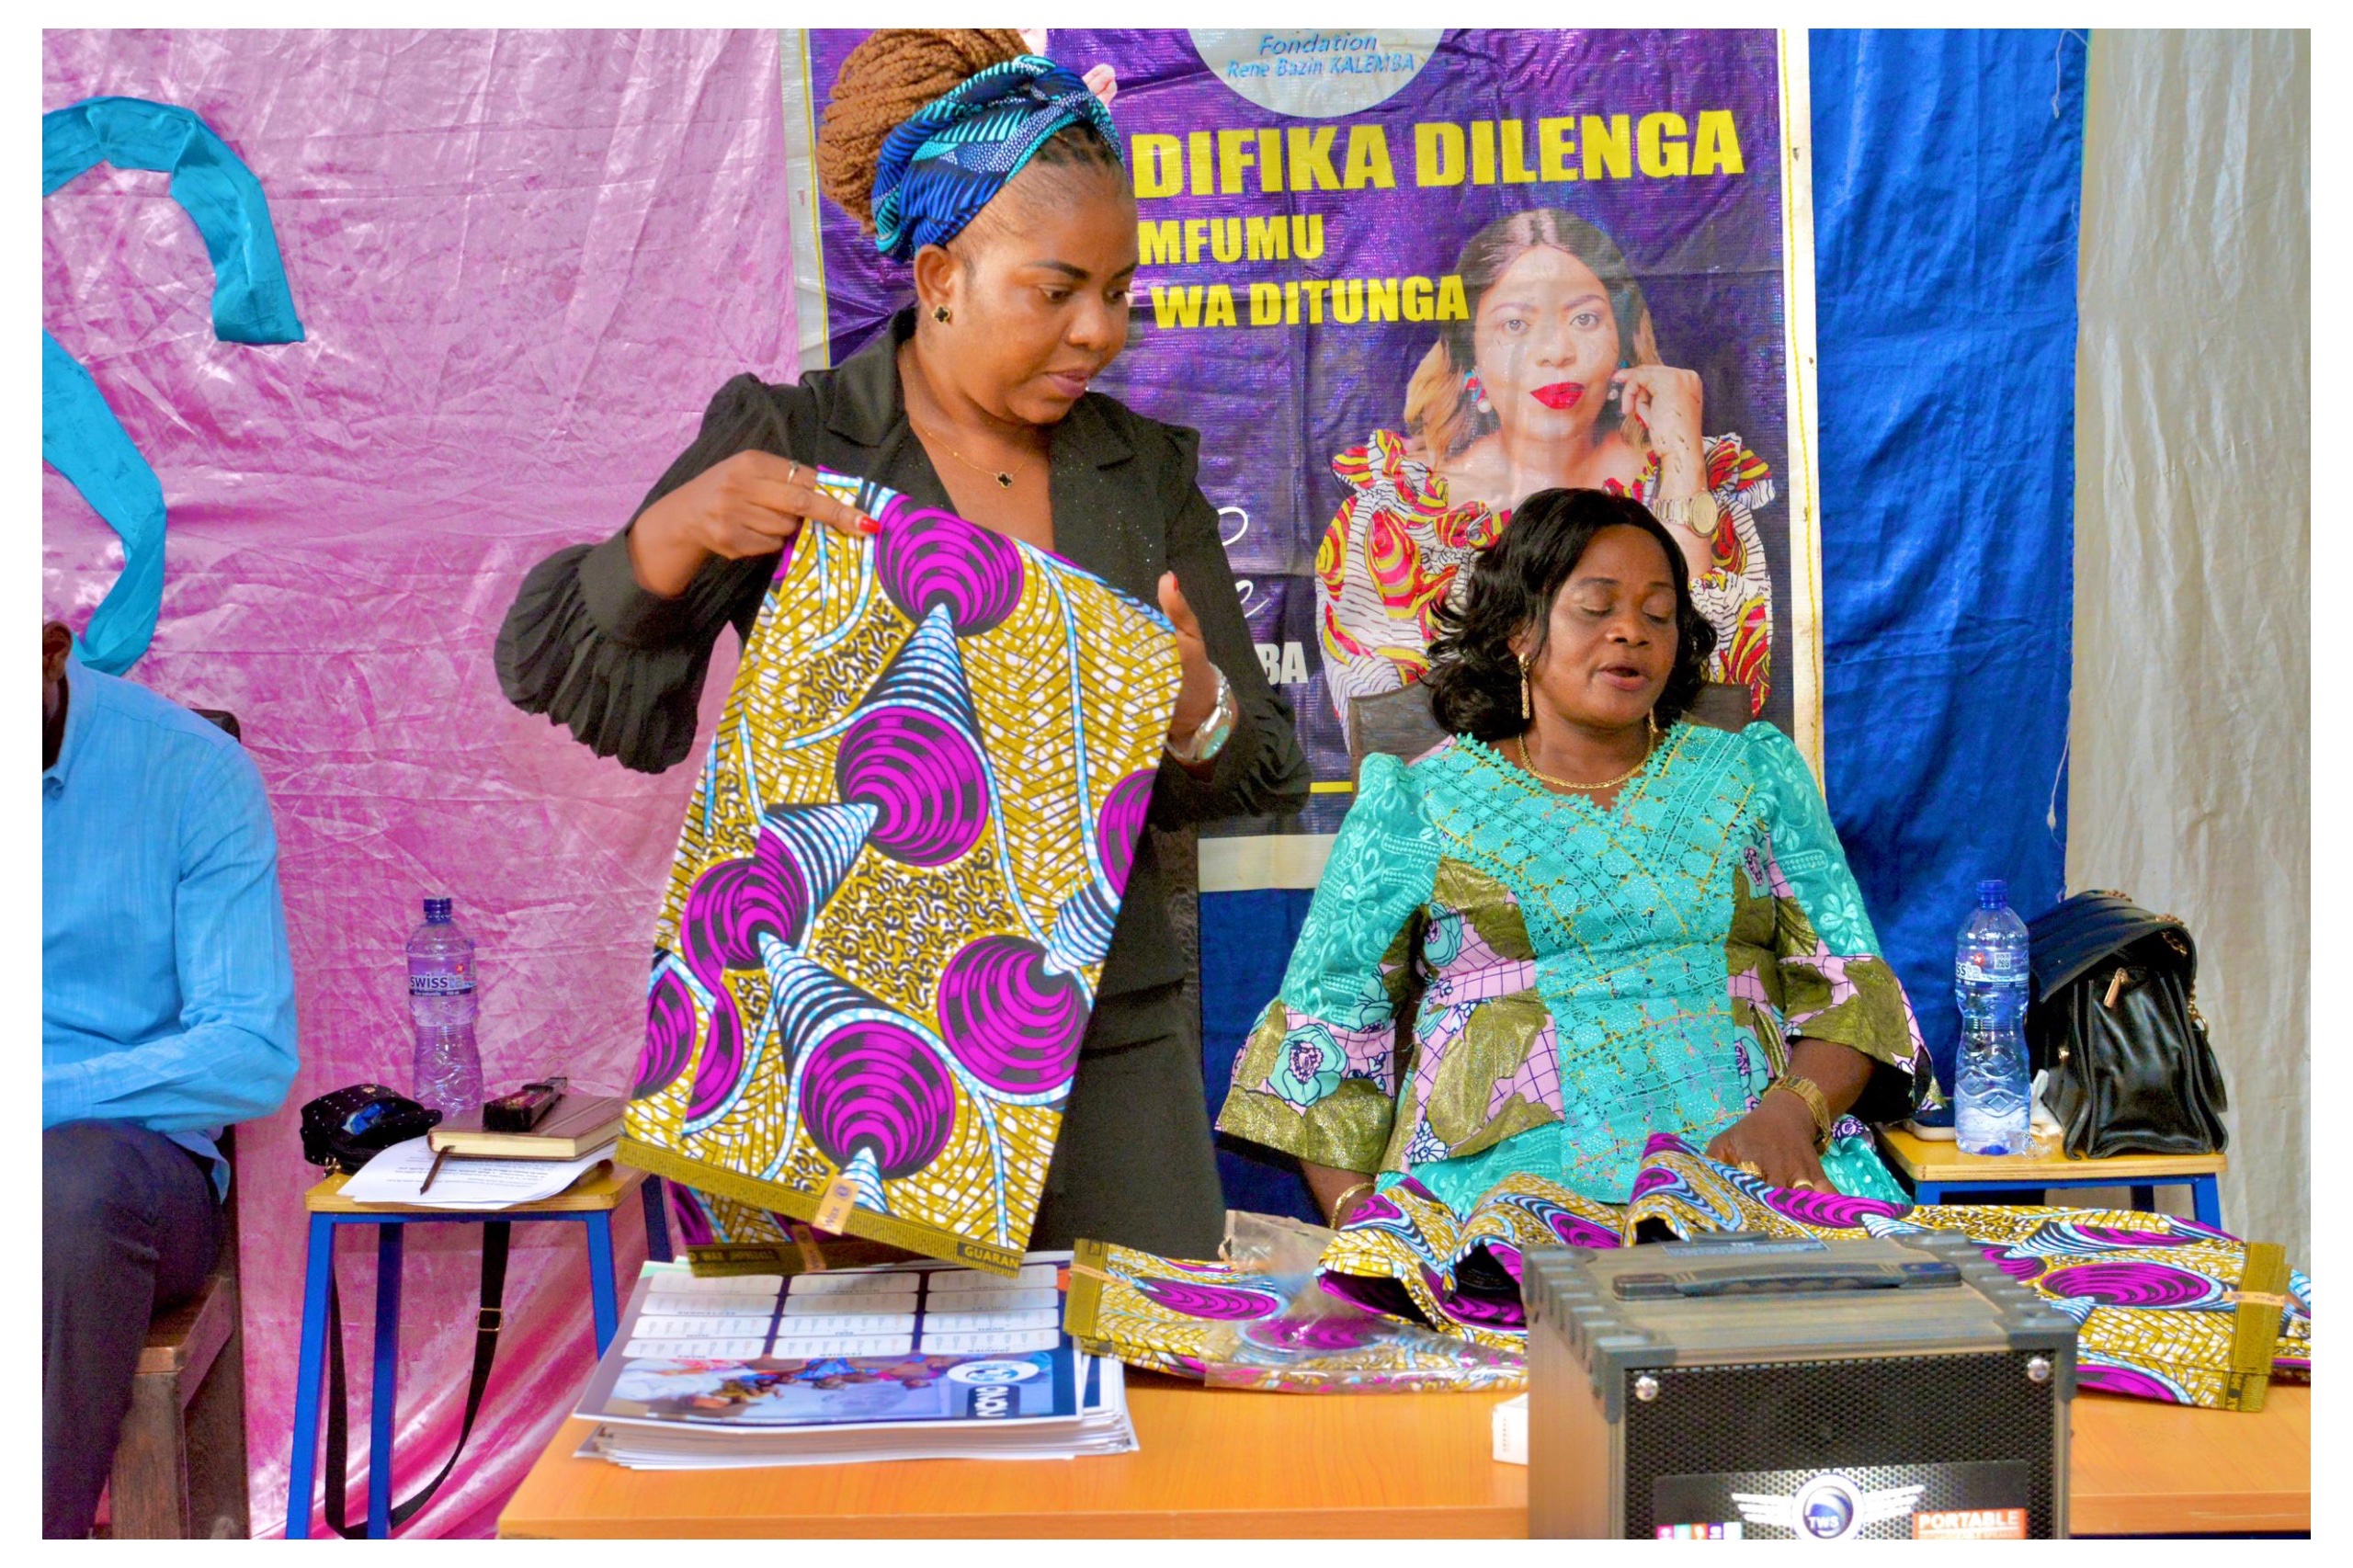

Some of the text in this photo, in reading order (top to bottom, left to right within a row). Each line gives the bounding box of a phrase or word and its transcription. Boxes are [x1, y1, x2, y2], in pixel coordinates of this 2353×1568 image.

[1258, 32, 1378, 56] Fondation
[1275, 55, 1324, 77] Bazin
[1329, 52, 1415, 74] KALEMBA
[1131, 109, 1745, 199] DIFIKA DILENGA
[1137, 213, 1325, 266] MFUMU
[1150, 275, 1469, 329] WA DITUNGA
[1807, 1516, 1839, 1530] TWS
[1917, 1510, 2019, 1529] PORTABLE
